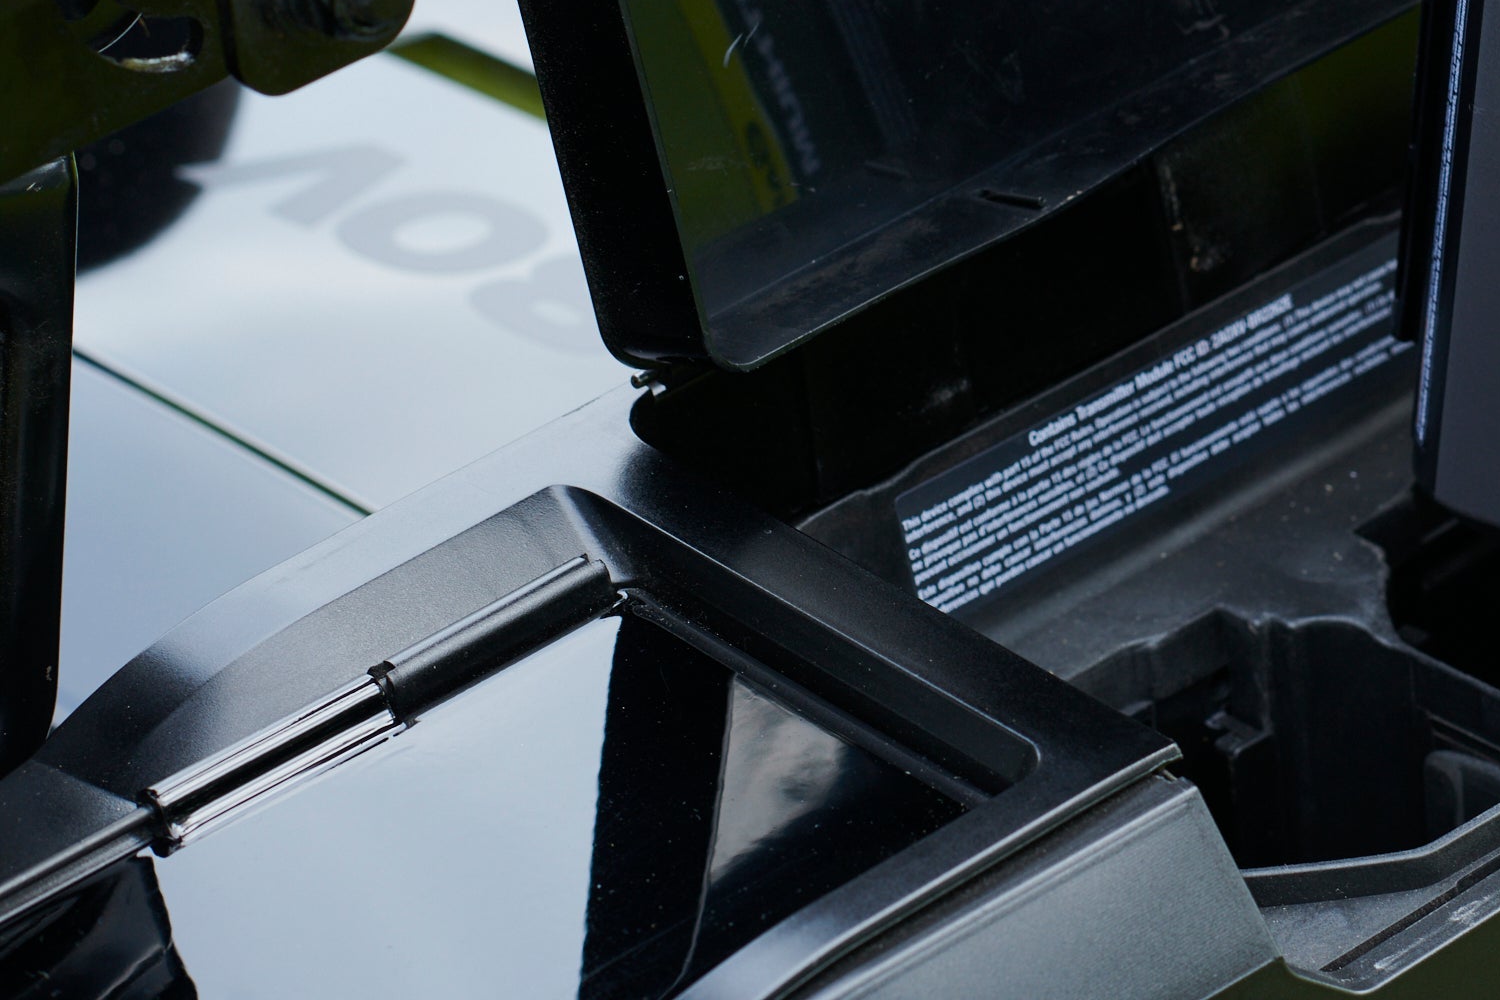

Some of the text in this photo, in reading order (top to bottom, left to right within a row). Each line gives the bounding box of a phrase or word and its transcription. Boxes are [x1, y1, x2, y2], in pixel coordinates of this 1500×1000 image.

[1027, 409, 1076, 447] Contains
[1074, 377, 1135, 422] Transmitter
[1133, 356, 1175, 391] Module
[1172, 344, 1196, 370] FCC
